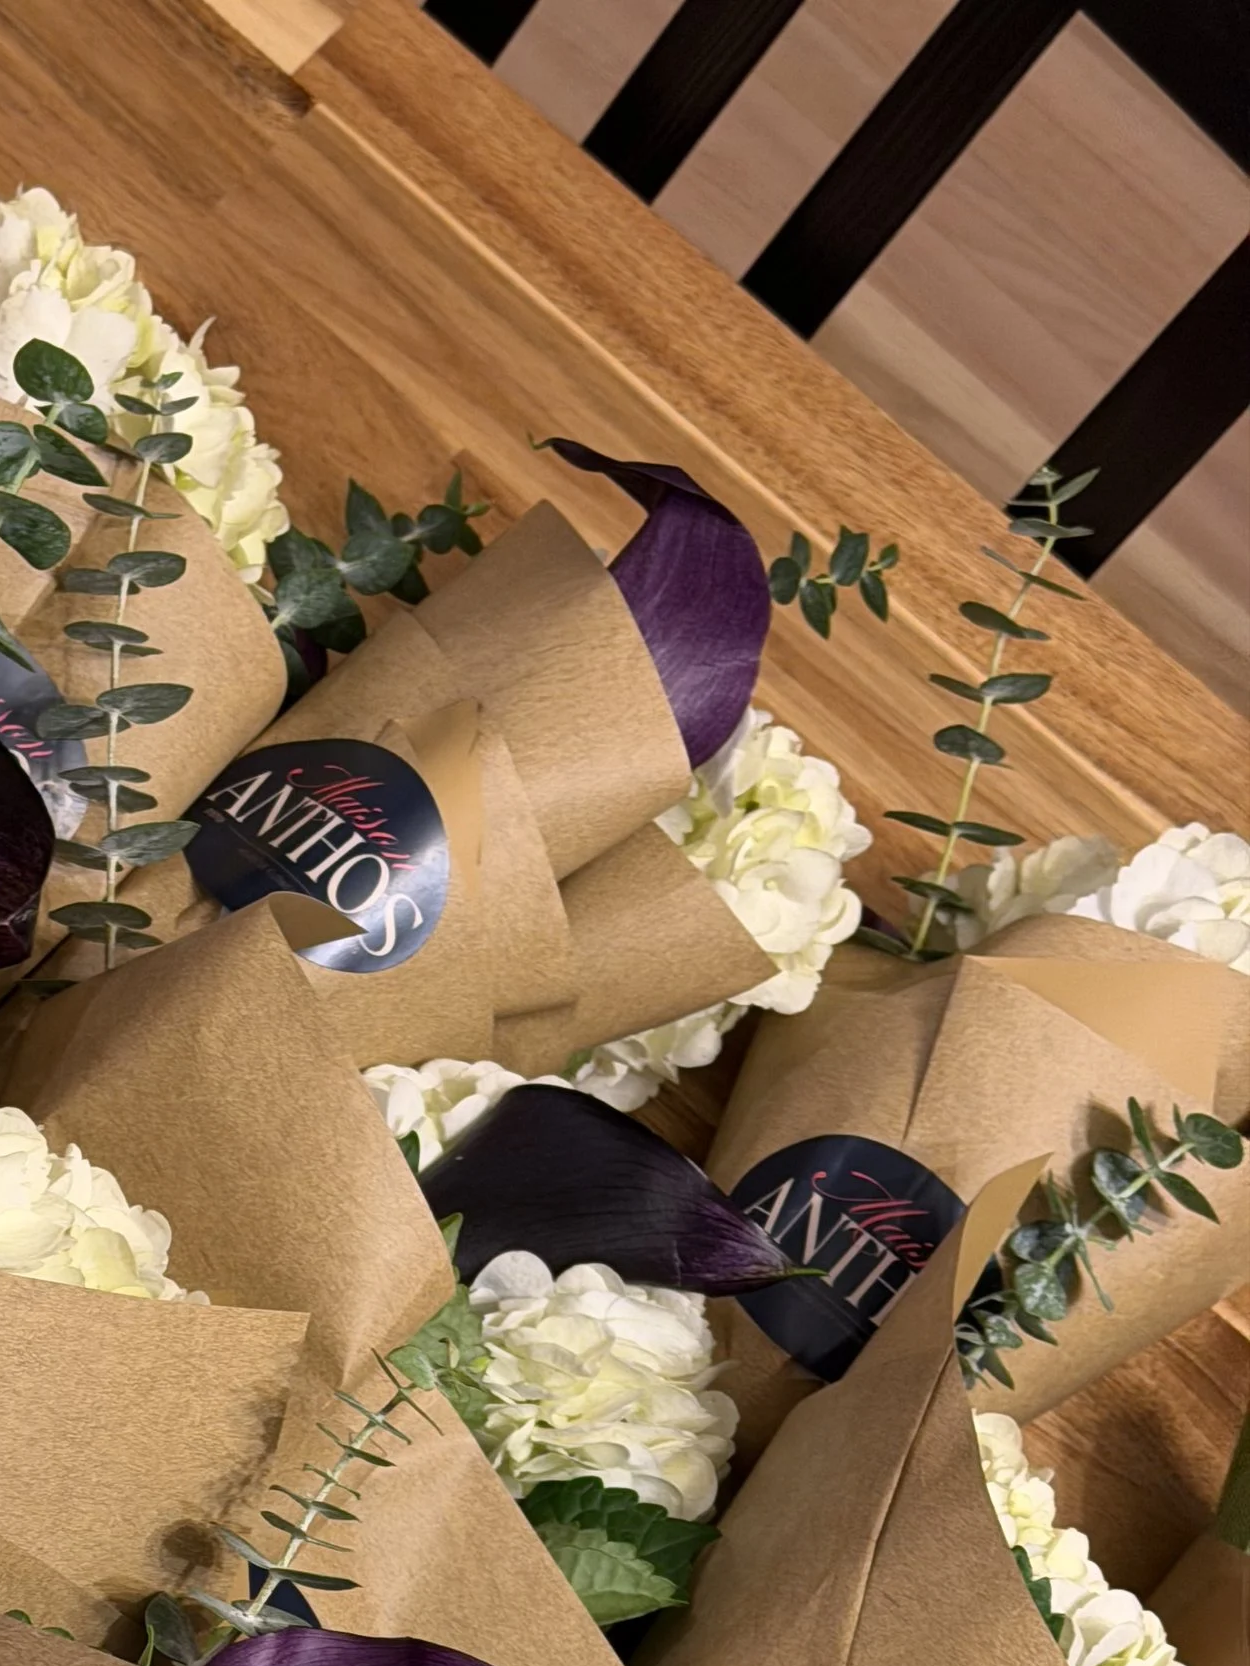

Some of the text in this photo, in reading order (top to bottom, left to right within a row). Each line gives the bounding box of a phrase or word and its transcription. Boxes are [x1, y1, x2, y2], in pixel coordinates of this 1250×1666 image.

[205, 770, 424, 957] ANTHOS
[286, 764, 417, 870] Maison
[742, 1178, 919, 1328] ANTH
